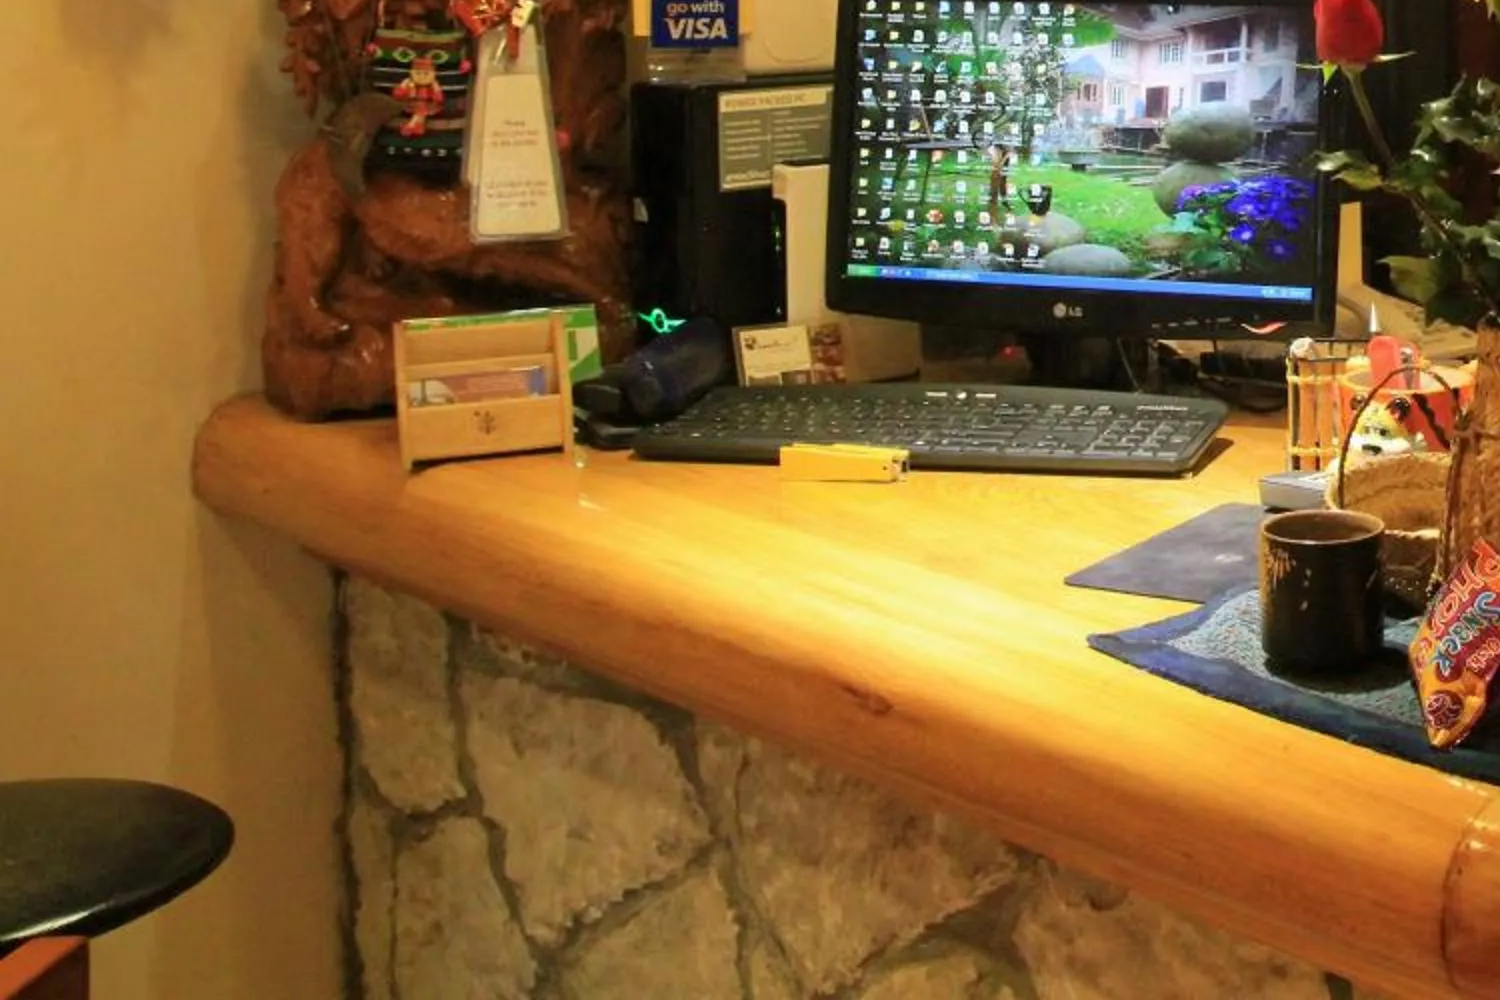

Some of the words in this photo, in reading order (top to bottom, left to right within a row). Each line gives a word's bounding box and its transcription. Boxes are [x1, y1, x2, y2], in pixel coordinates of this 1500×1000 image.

[666, 2, 688, 17] go
[690, 0, 724, 13] with
[664, 17, 728, 40] VISA
